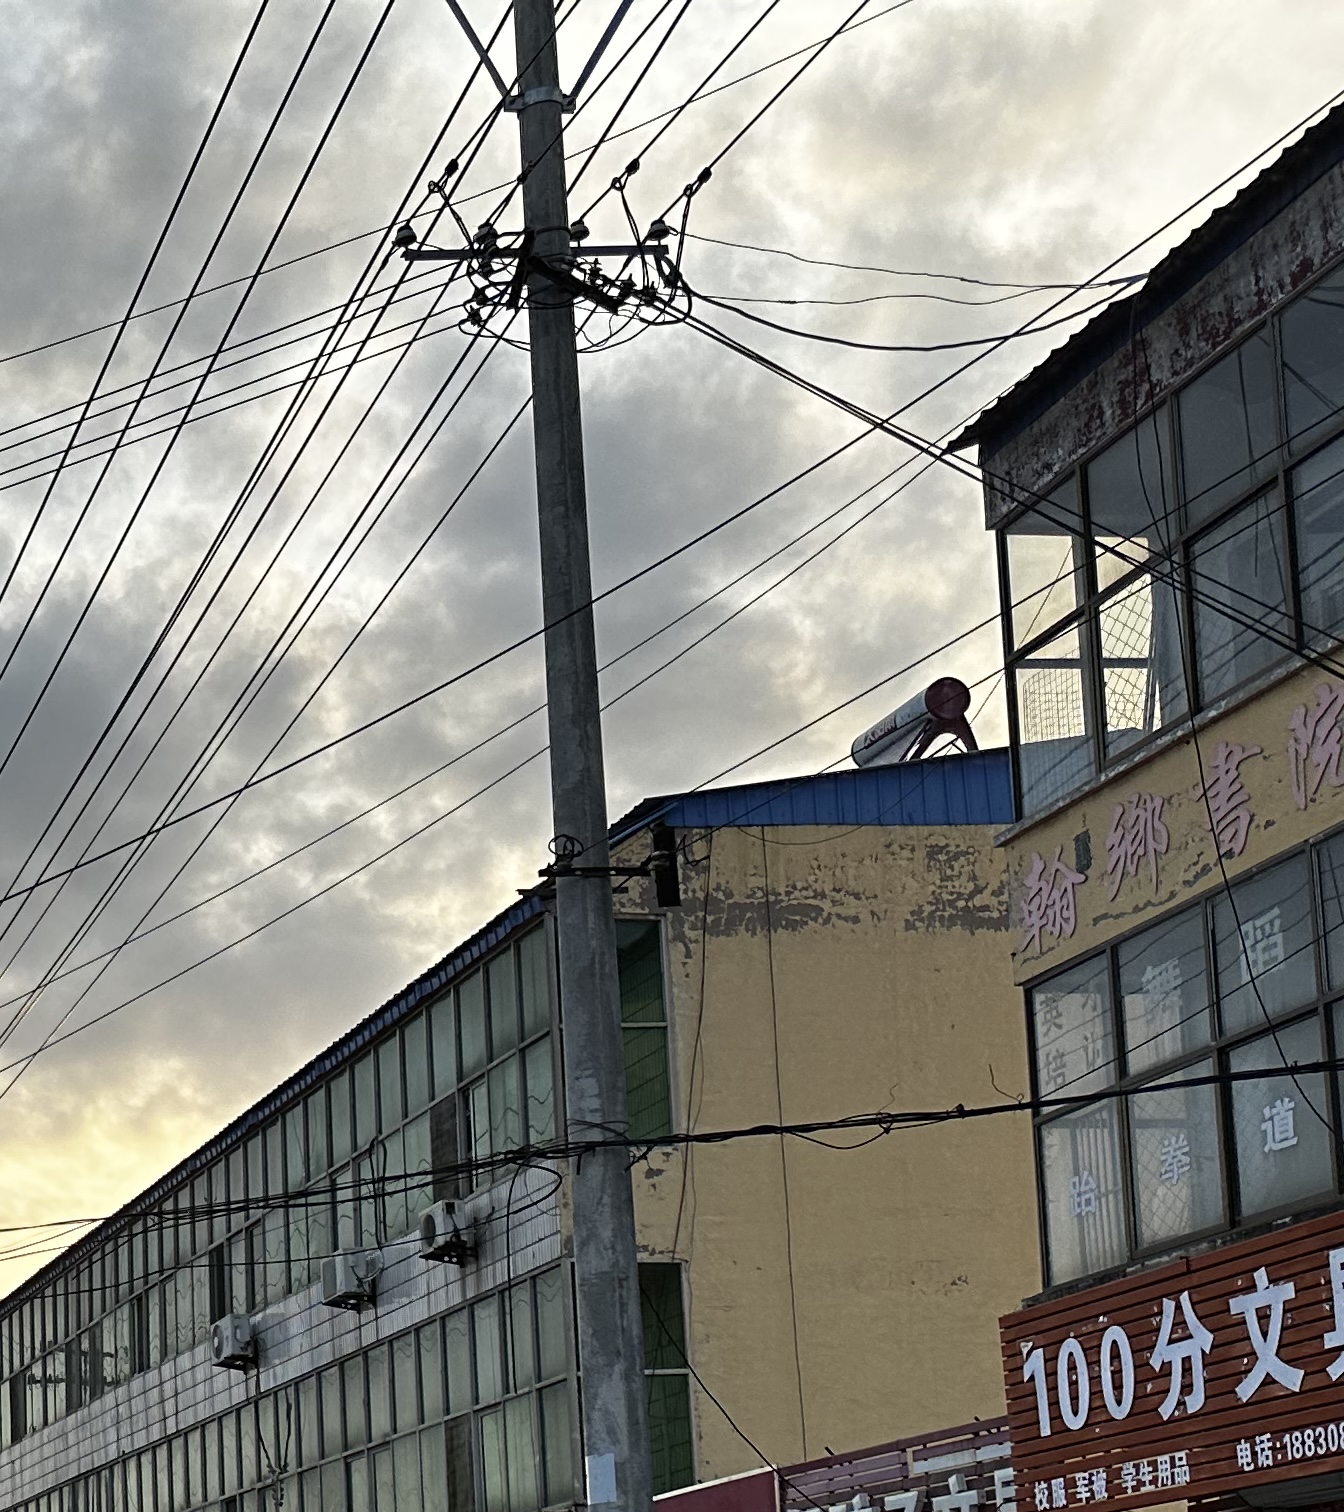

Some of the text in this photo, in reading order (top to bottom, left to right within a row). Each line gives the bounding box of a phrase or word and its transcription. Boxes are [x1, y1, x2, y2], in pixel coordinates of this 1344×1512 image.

[1023, 1248, 1344, 1437] 100分文
[1033, 1478, 1067, 1511] 校服
[1120, 1450, 1191, 1494] 学生用品
